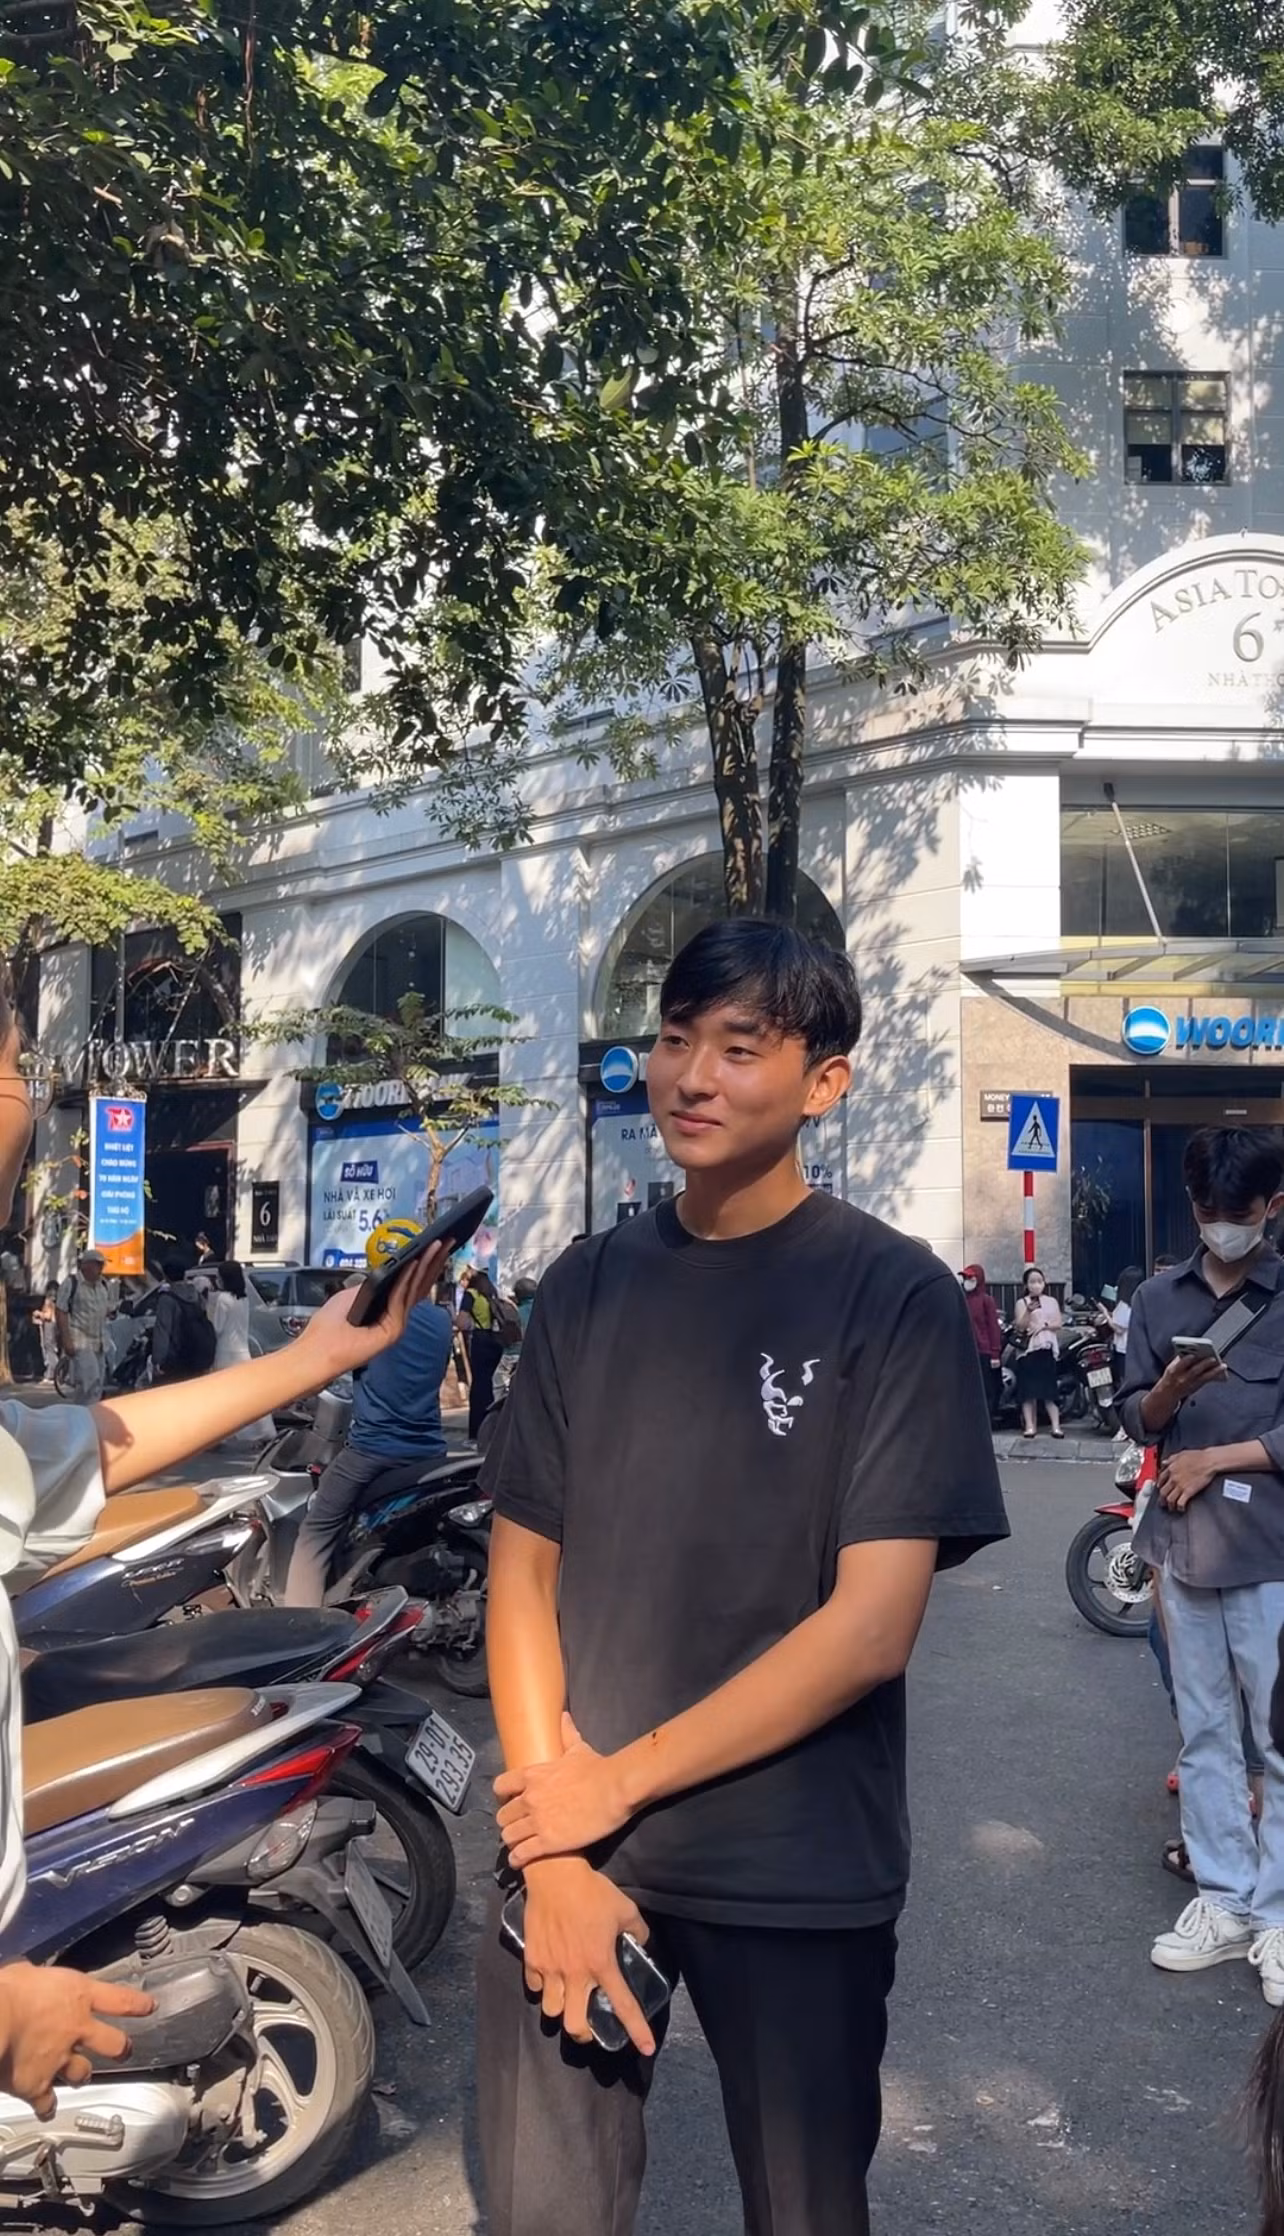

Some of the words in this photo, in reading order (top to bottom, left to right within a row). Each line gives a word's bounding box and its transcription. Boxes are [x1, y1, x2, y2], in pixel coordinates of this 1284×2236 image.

[1150, 577, 1232, 634] ASIA
[1233, 611, 1264, 662] 6
[260, 1201, 270, 1226] 6
[363, 1188, 375, 1200] XE
[435, 1735, 474, 1806] 293.35
